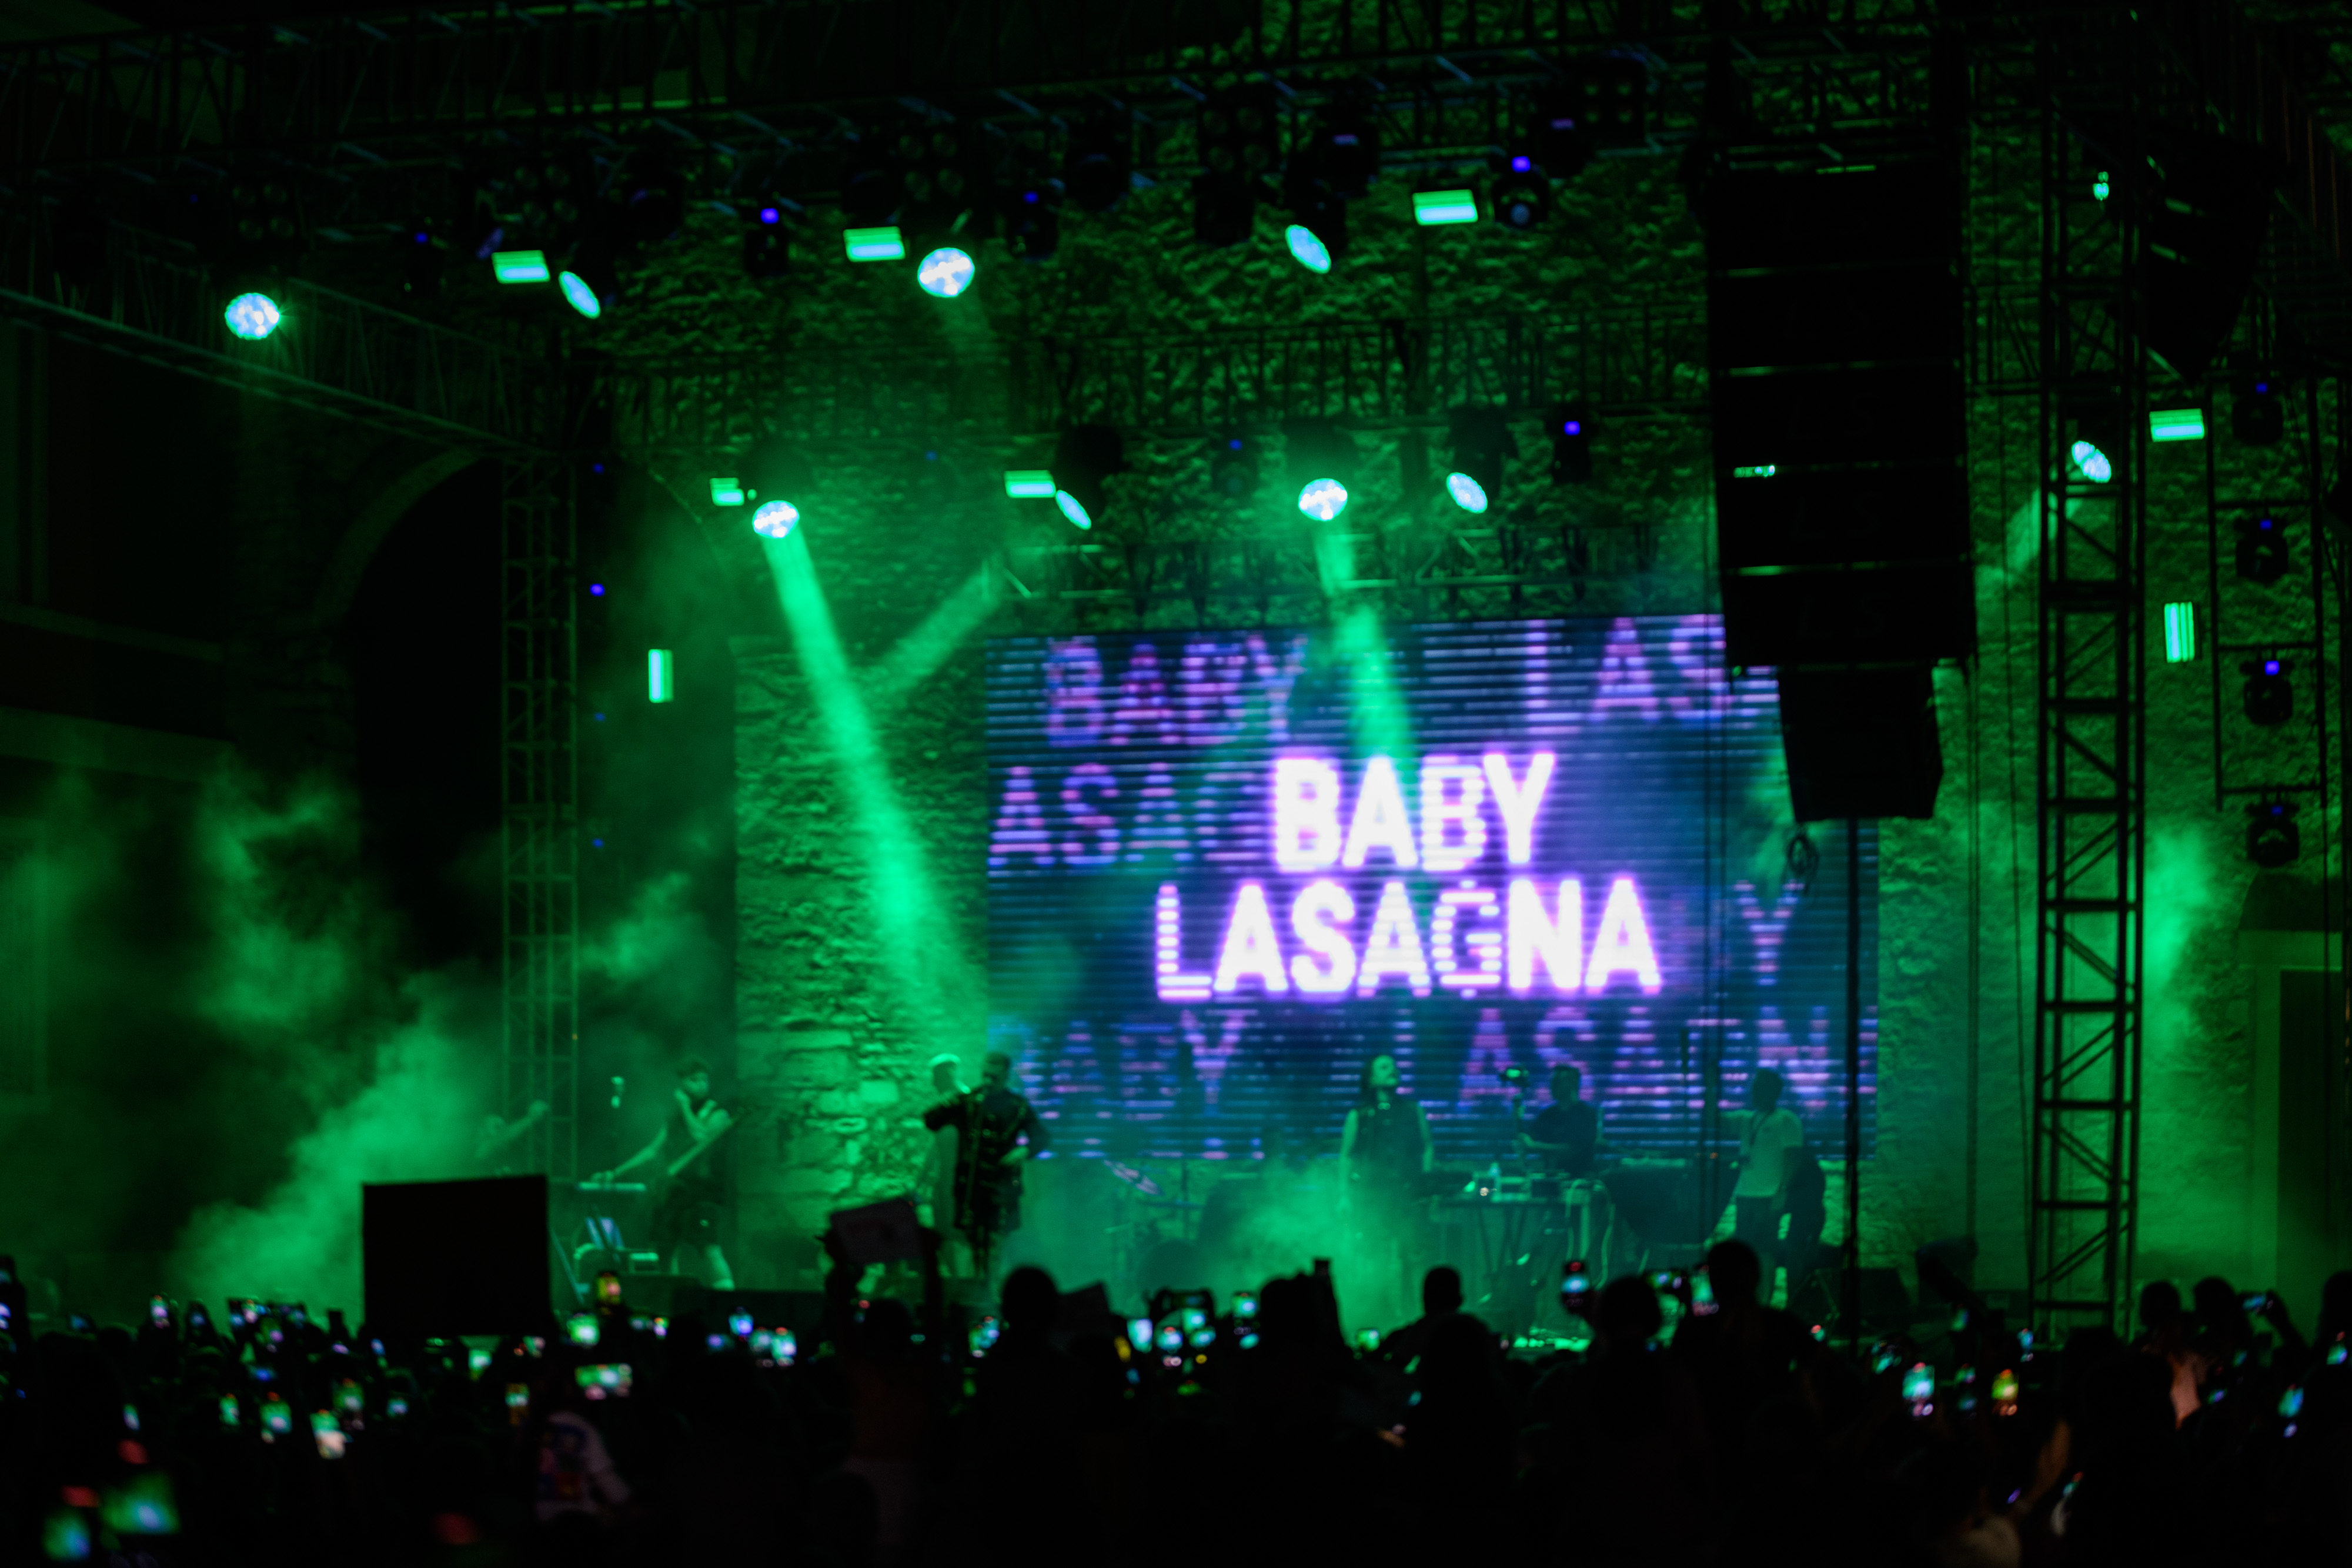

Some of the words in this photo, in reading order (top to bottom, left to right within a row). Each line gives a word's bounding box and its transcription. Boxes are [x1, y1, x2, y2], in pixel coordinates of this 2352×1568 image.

[1045, 635, 1307, 745] BABY
[1524, 611, 1779, 735] LAS
[1272, 751, 1556, 871] BABY
[1157, 878, 1662, 1001] LASAGNA
